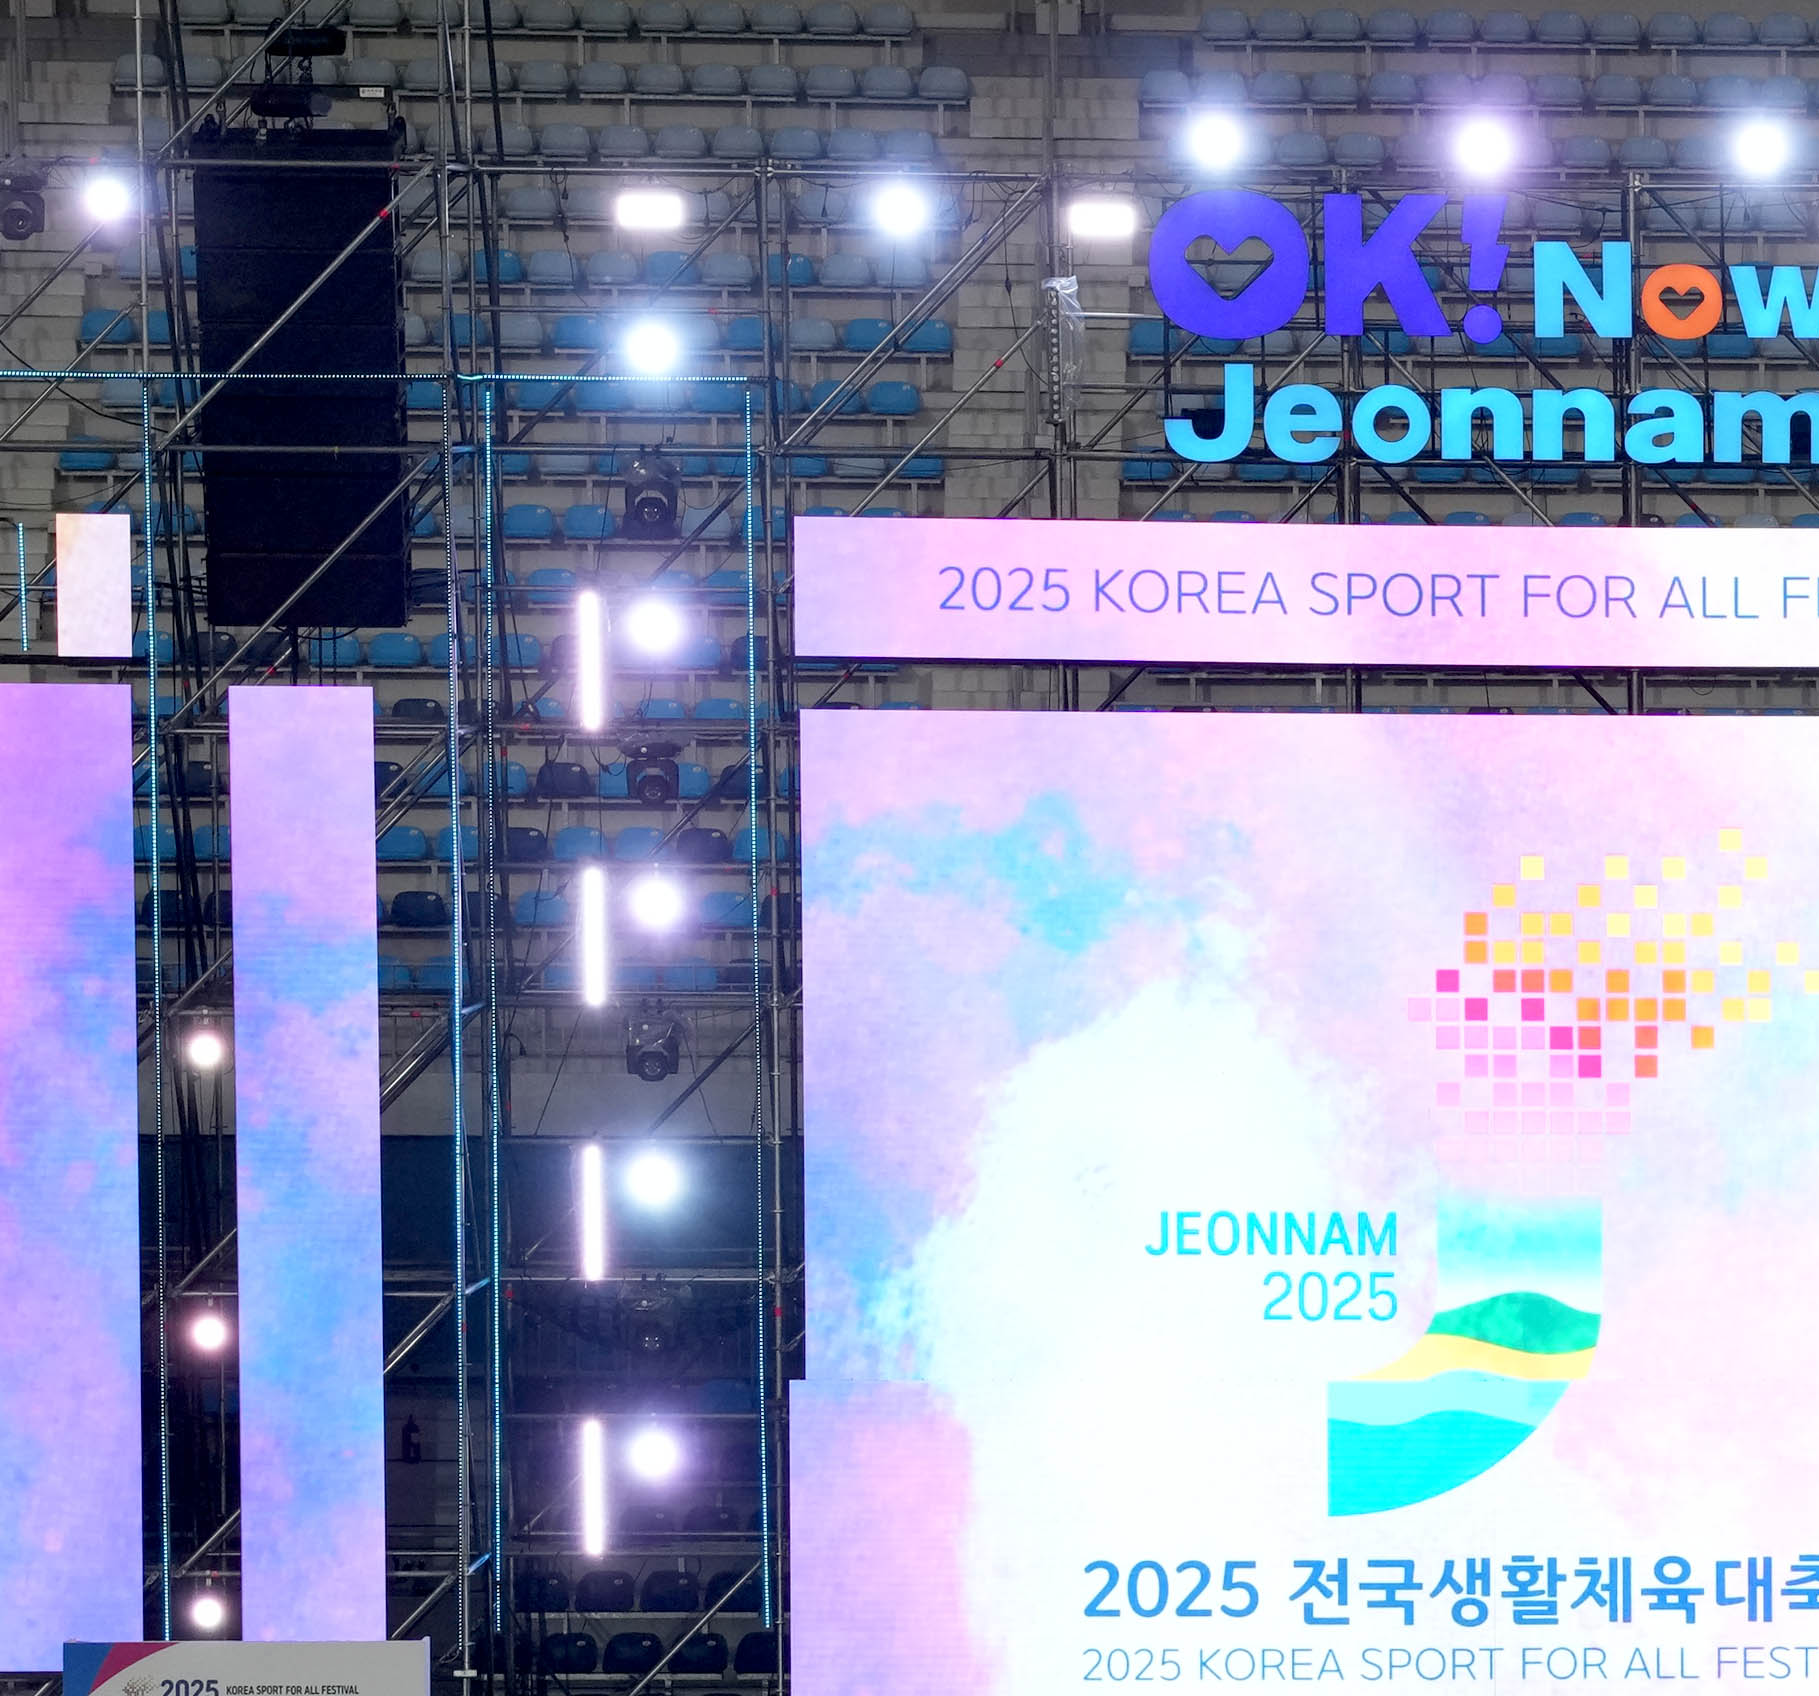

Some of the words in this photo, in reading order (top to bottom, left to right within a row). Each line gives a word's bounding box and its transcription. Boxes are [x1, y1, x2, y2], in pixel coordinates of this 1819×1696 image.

[1149, 189, 1509, 344] OK!
[938, 566, 1070, 612] 2025
[1095, 568, 1288, 616] KOREA
[1308, 572, 1500, 618] SPORT
[1522, 574, 1637, 619] FOR
[1659, 575, 1760, 620] ALL
[1145, 1211, 1399, 1257] JEONNAM
[1262, 1271, 1399, 1322] 2025
[1081, 1558, 1260, 1620] 2025
[226, 1685, 254, 1696] KOREA
[256, 1685, 284, 1696] SPORT
[286, 1685, 303, 1695] FOR
[304, 1685, 320, 1695] ALL
[321, 1684, 360, 1695] FESTIVAL
[1082, 1647, 1182, 1683] 2025
[1200, 1646, 1345, 1682] KOREA
[1360, 1646, 1505, 1682] SPORT
[1520, 1646, 1607, 1681] FOR
[1624, 1646, 1700, 1681] ALL
